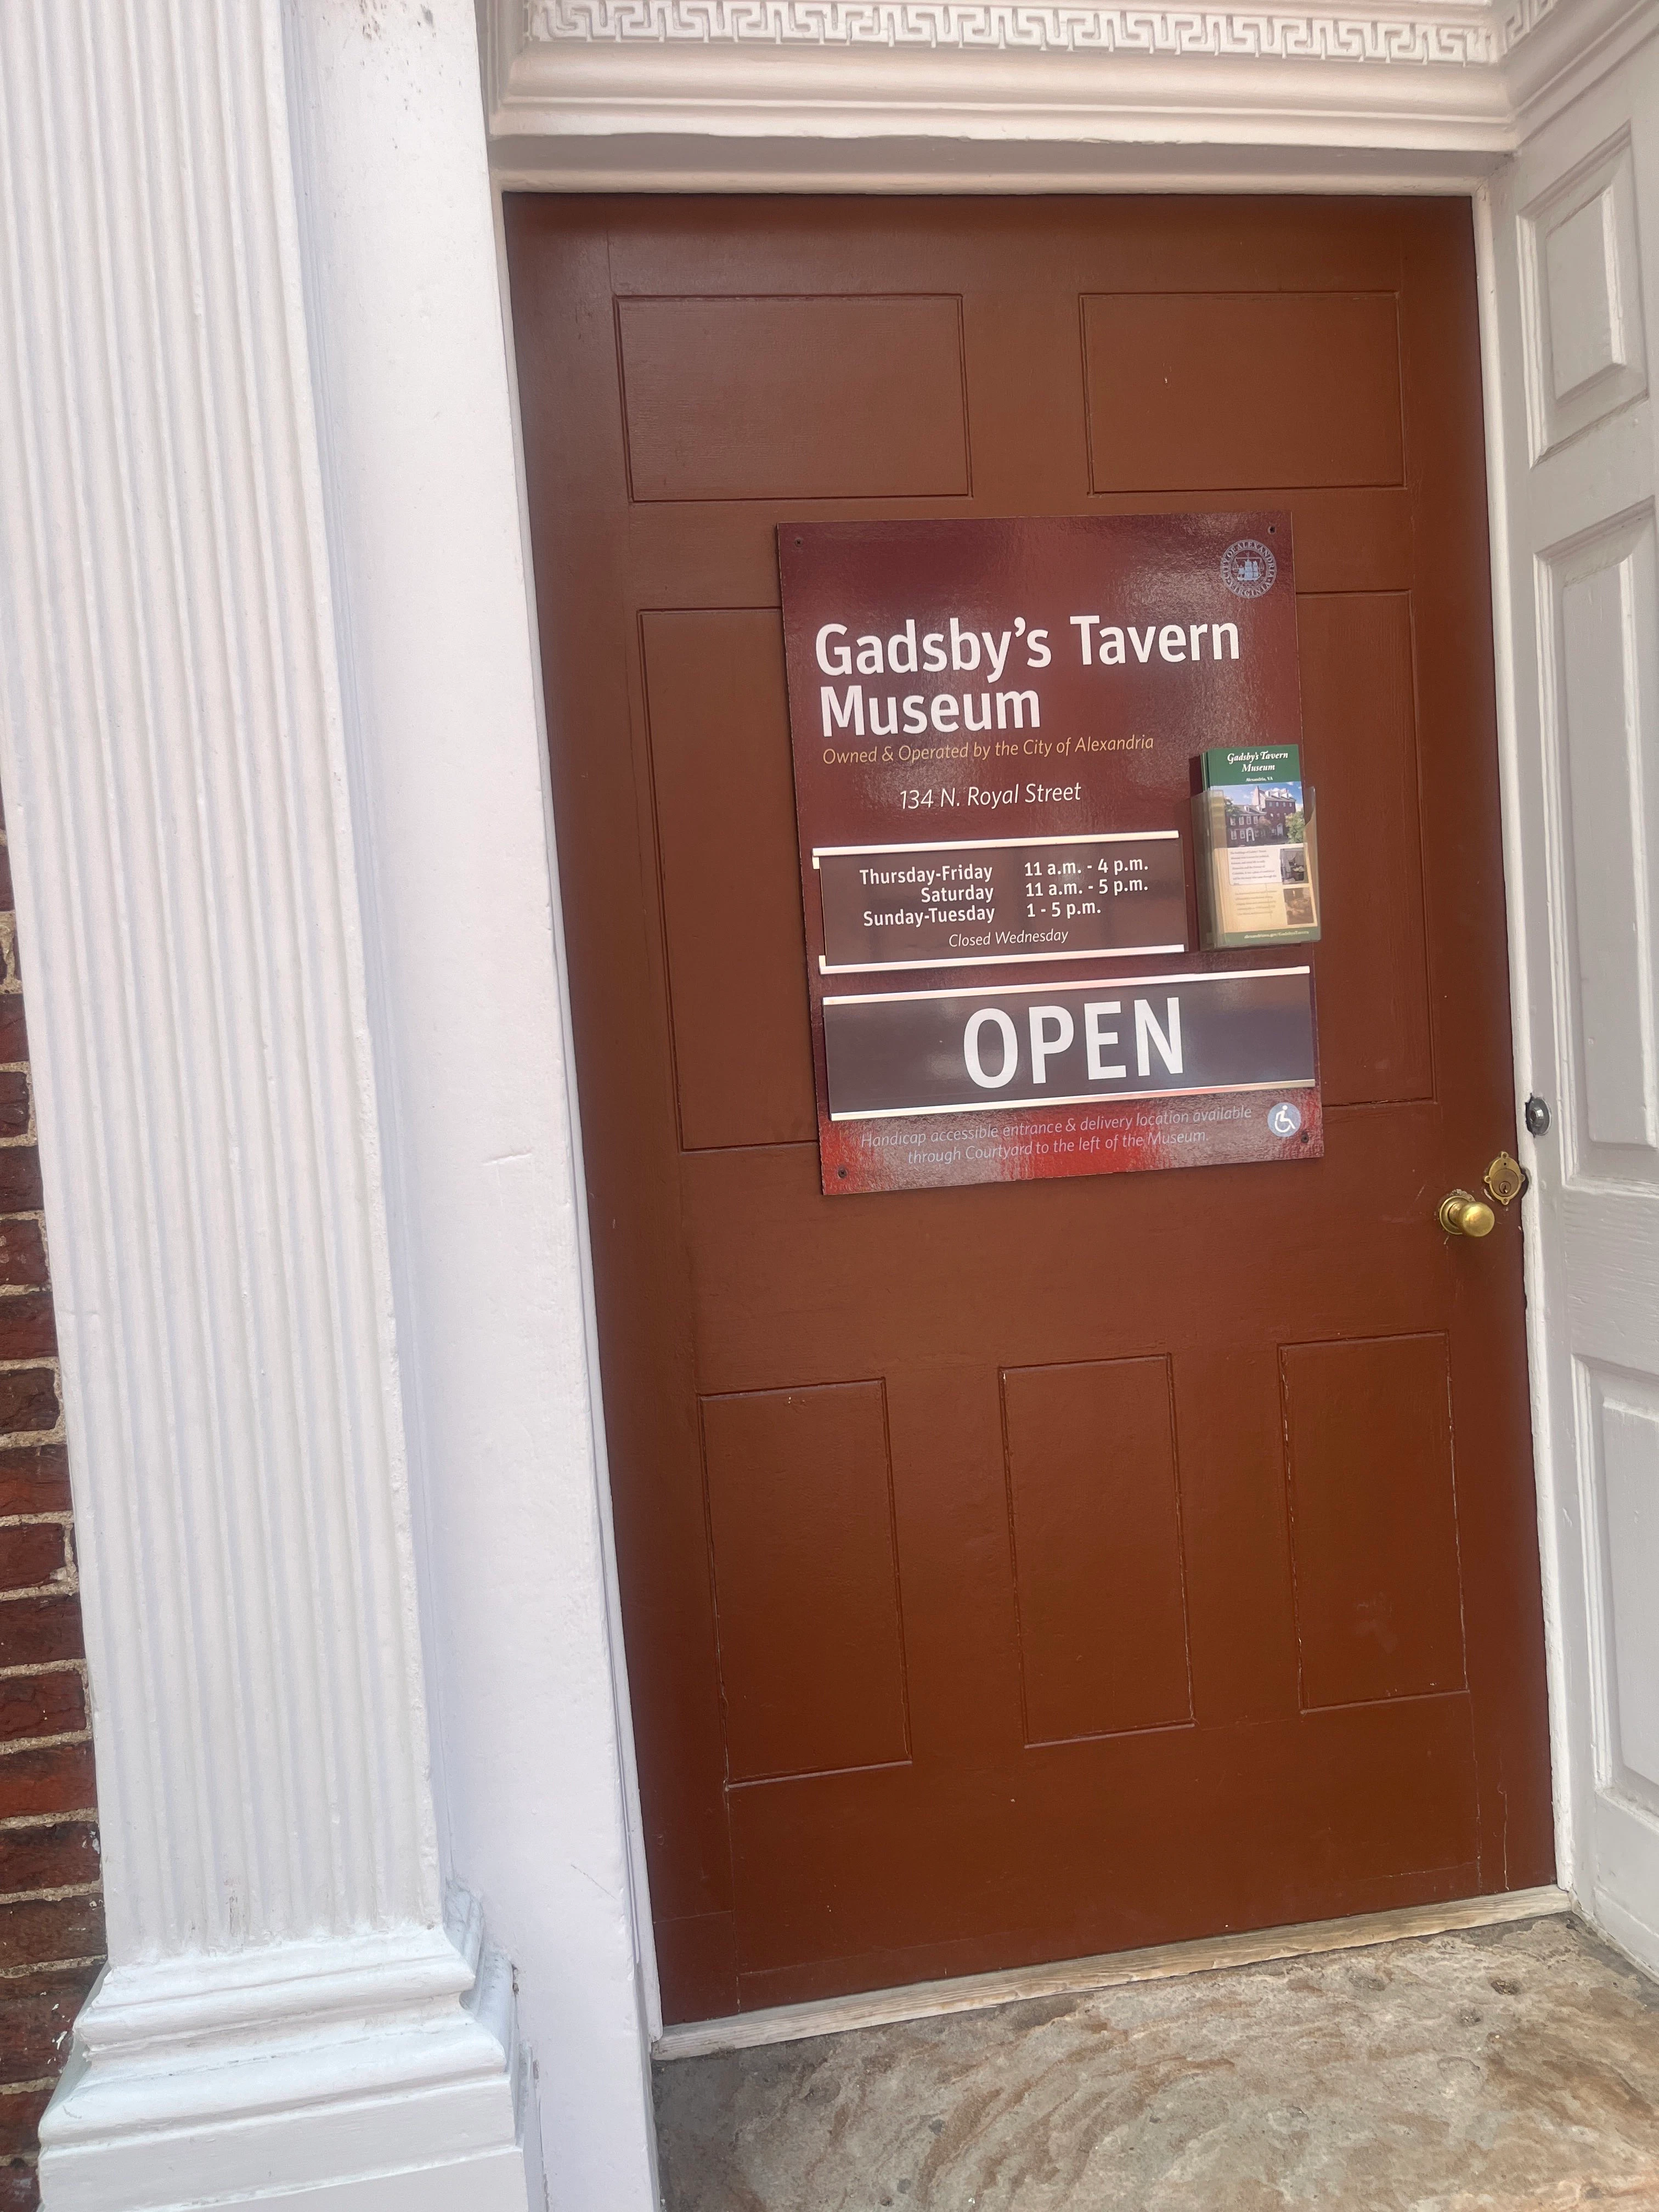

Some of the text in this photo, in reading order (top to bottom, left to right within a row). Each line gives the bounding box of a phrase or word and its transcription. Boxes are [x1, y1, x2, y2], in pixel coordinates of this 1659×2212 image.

[1237, 541, 1275, 578] ALEXANDRIA
[1227, 582, 1271, 597] VIRGINIA
[815, 615, 1240, 683] Gadsby's Tavern
[821, 685, 1040, 737] Museum
[823, 734, 1154, 764] Owned & Operated by the City of Alexandria
[1260, 751, 1288, 760] Tavern
[1241, 764, 1275, 772] Museum
[900, 782, 1082, 810] 134 N. Royal Street
[859, 865, 992, 885] Thursday-Friday
[1024, 862, 1043, 877] 11
[1047, 863, 1082, 875] a.m.
[1098, 859, 1109, 872] 4
[1114, 858, 1149, 876] p.m.
[921, 886, 994, 904] Saturday
[1025, 883, 1043, 897] 11
[1048, 883, 1083, 895] a.m.
[1099, 879, 1108, 894] 5
[1114, 879, 1149, 895] p.m.
[863, 906, 995, 927] Sunday-Tuesday
[1027, 904, 1036, 917] 1
[1051, 902, 1061, 917] 5
[1066, 901, 1101, 918] p.m.
[949, 928, 1069, 947] Closed Wednesday
[963, 996, 1183, 1089] OPEN
[861, 1105, 1252, 1148] Handicap accessible entrance & delivery location available
[908, 1130, 1209, 1164] through Courtyard to the left of the Museum.
